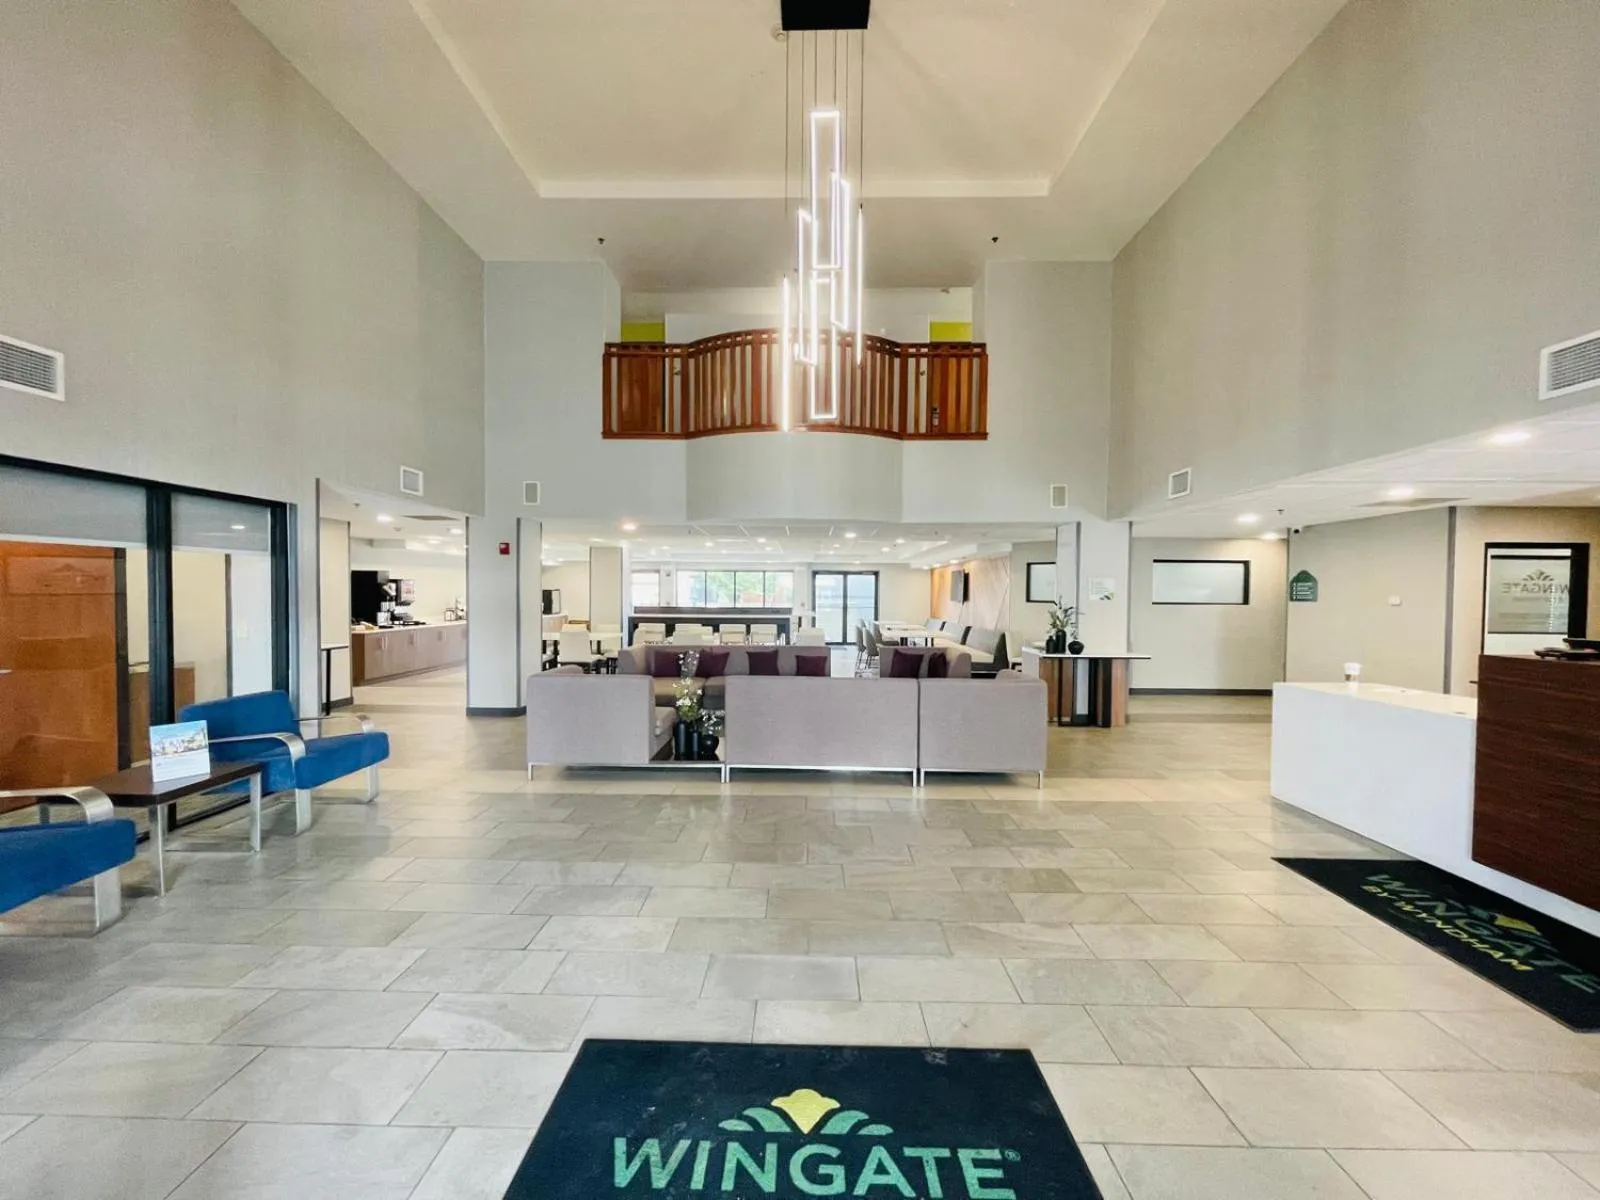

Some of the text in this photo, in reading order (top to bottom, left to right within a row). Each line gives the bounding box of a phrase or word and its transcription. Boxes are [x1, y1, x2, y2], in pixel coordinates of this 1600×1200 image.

[1361, 885, 1534, 972] BY WYNDHAM
[1365, 874, 1600, 993] WINGATE
